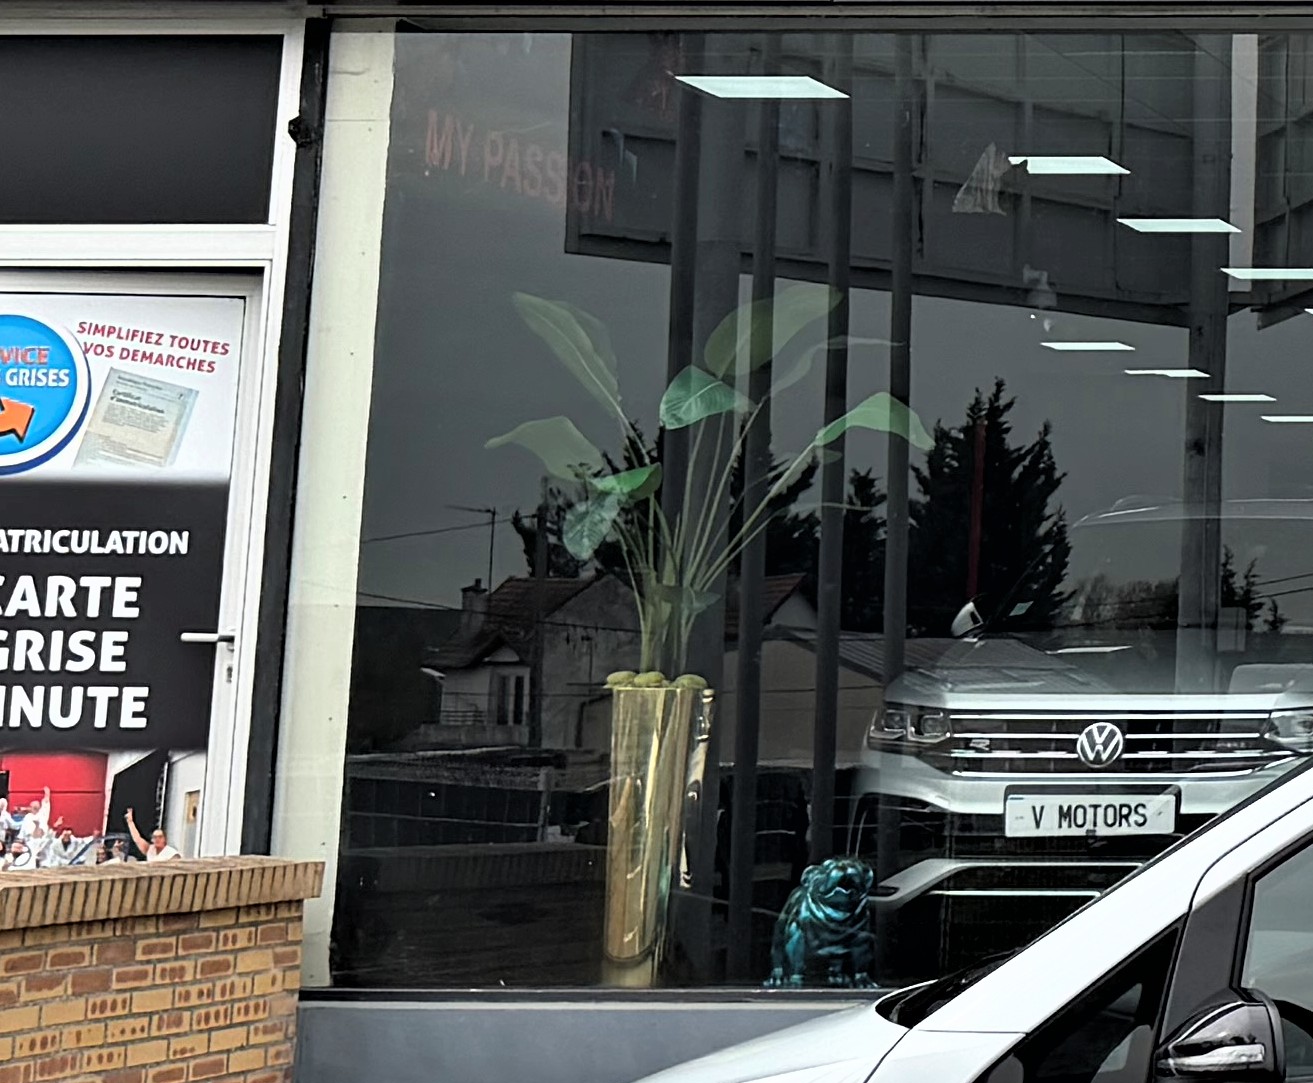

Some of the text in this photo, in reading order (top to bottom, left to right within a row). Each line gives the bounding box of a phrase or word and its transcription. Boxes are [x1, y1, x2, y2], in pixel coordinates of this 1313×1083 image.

[76, 321, 231, 356] SIMPLIFIEZ TOUTES
[83, 341, 217, 373] VOS DEMARCHES
[5, 367, 70, 387] GRISES
[0, 574, 142, 619] ARTE
[0, 629, 129, 673] RISE
[1031, 802, 1149, 830] V MOTORS
